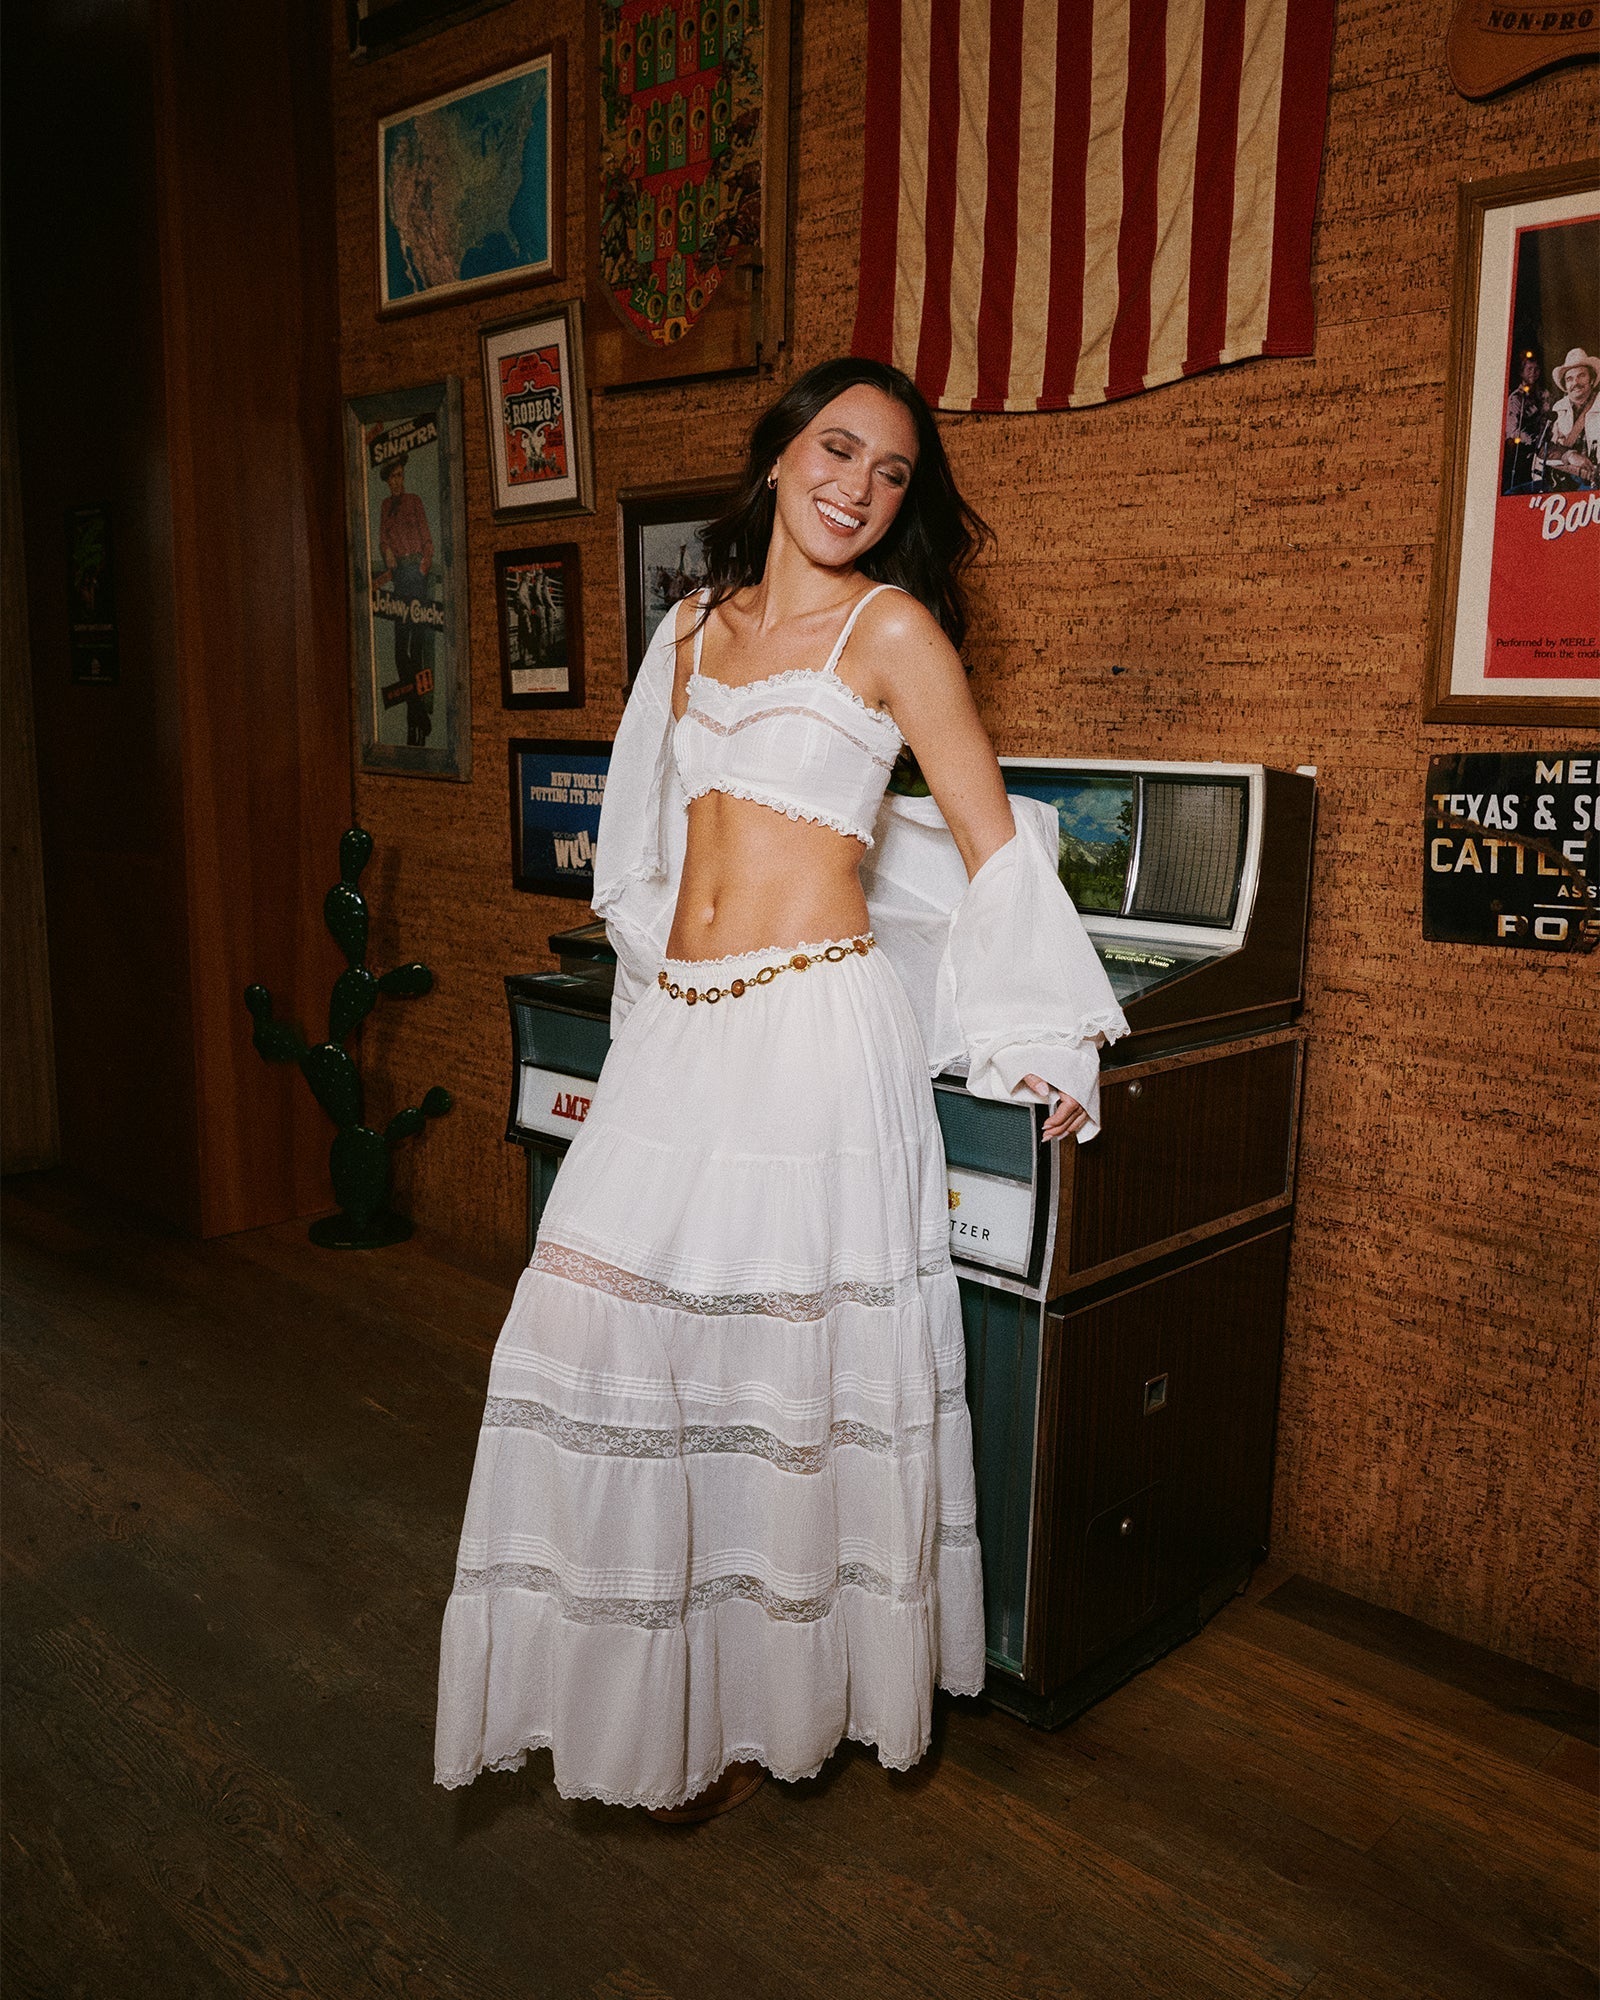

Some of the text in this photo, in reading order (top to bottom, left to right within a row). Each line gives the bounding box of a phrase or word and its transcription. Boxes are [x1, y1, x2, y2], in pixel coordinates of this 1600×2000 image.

[1487, 8, 1594, 31] NON-PRO
[622, 66, 629, 83] 8
[641, 59, 649, 77] 9
[659, 52, 672, 72] 10
[682, 45, 693, 63] 11
[703, 37, 715, 57] 12
[651, 146, 661, 162] 15
[671, 139, 682, 156] 16
[693, 133, 704, 150] 17
[714, 126, 726, 144] 18
[640, 220, 716, 251] 19 20 21 22
[669, 273, 682, 289] 24
[704, 273, 719, 294] 25
[634, 287, 649, 307] 23
[512, 398, 552, 426] RODEO
[373, 421, 438, 463] SINATRA
[1496, 637, 1596, 649] Performed by MERLE
[1533, 649, 1556, 658] from
[1560, 649, 1574, 658] the
[550, 771, 572, 788] NEW
[572, 773, 597, 790] YORK
[1534, 759, 1600, 784] ME
[530, 785, 568, 803] PUTTING
[569, 789, 585, 805] ITS
[1432, 793, 1519, 830] TEXAS
[1533, 794, 1557, 831] &
[1430, 837, 1587, 877] CATTLE
[1556, 884, 1600, 899] ASS
